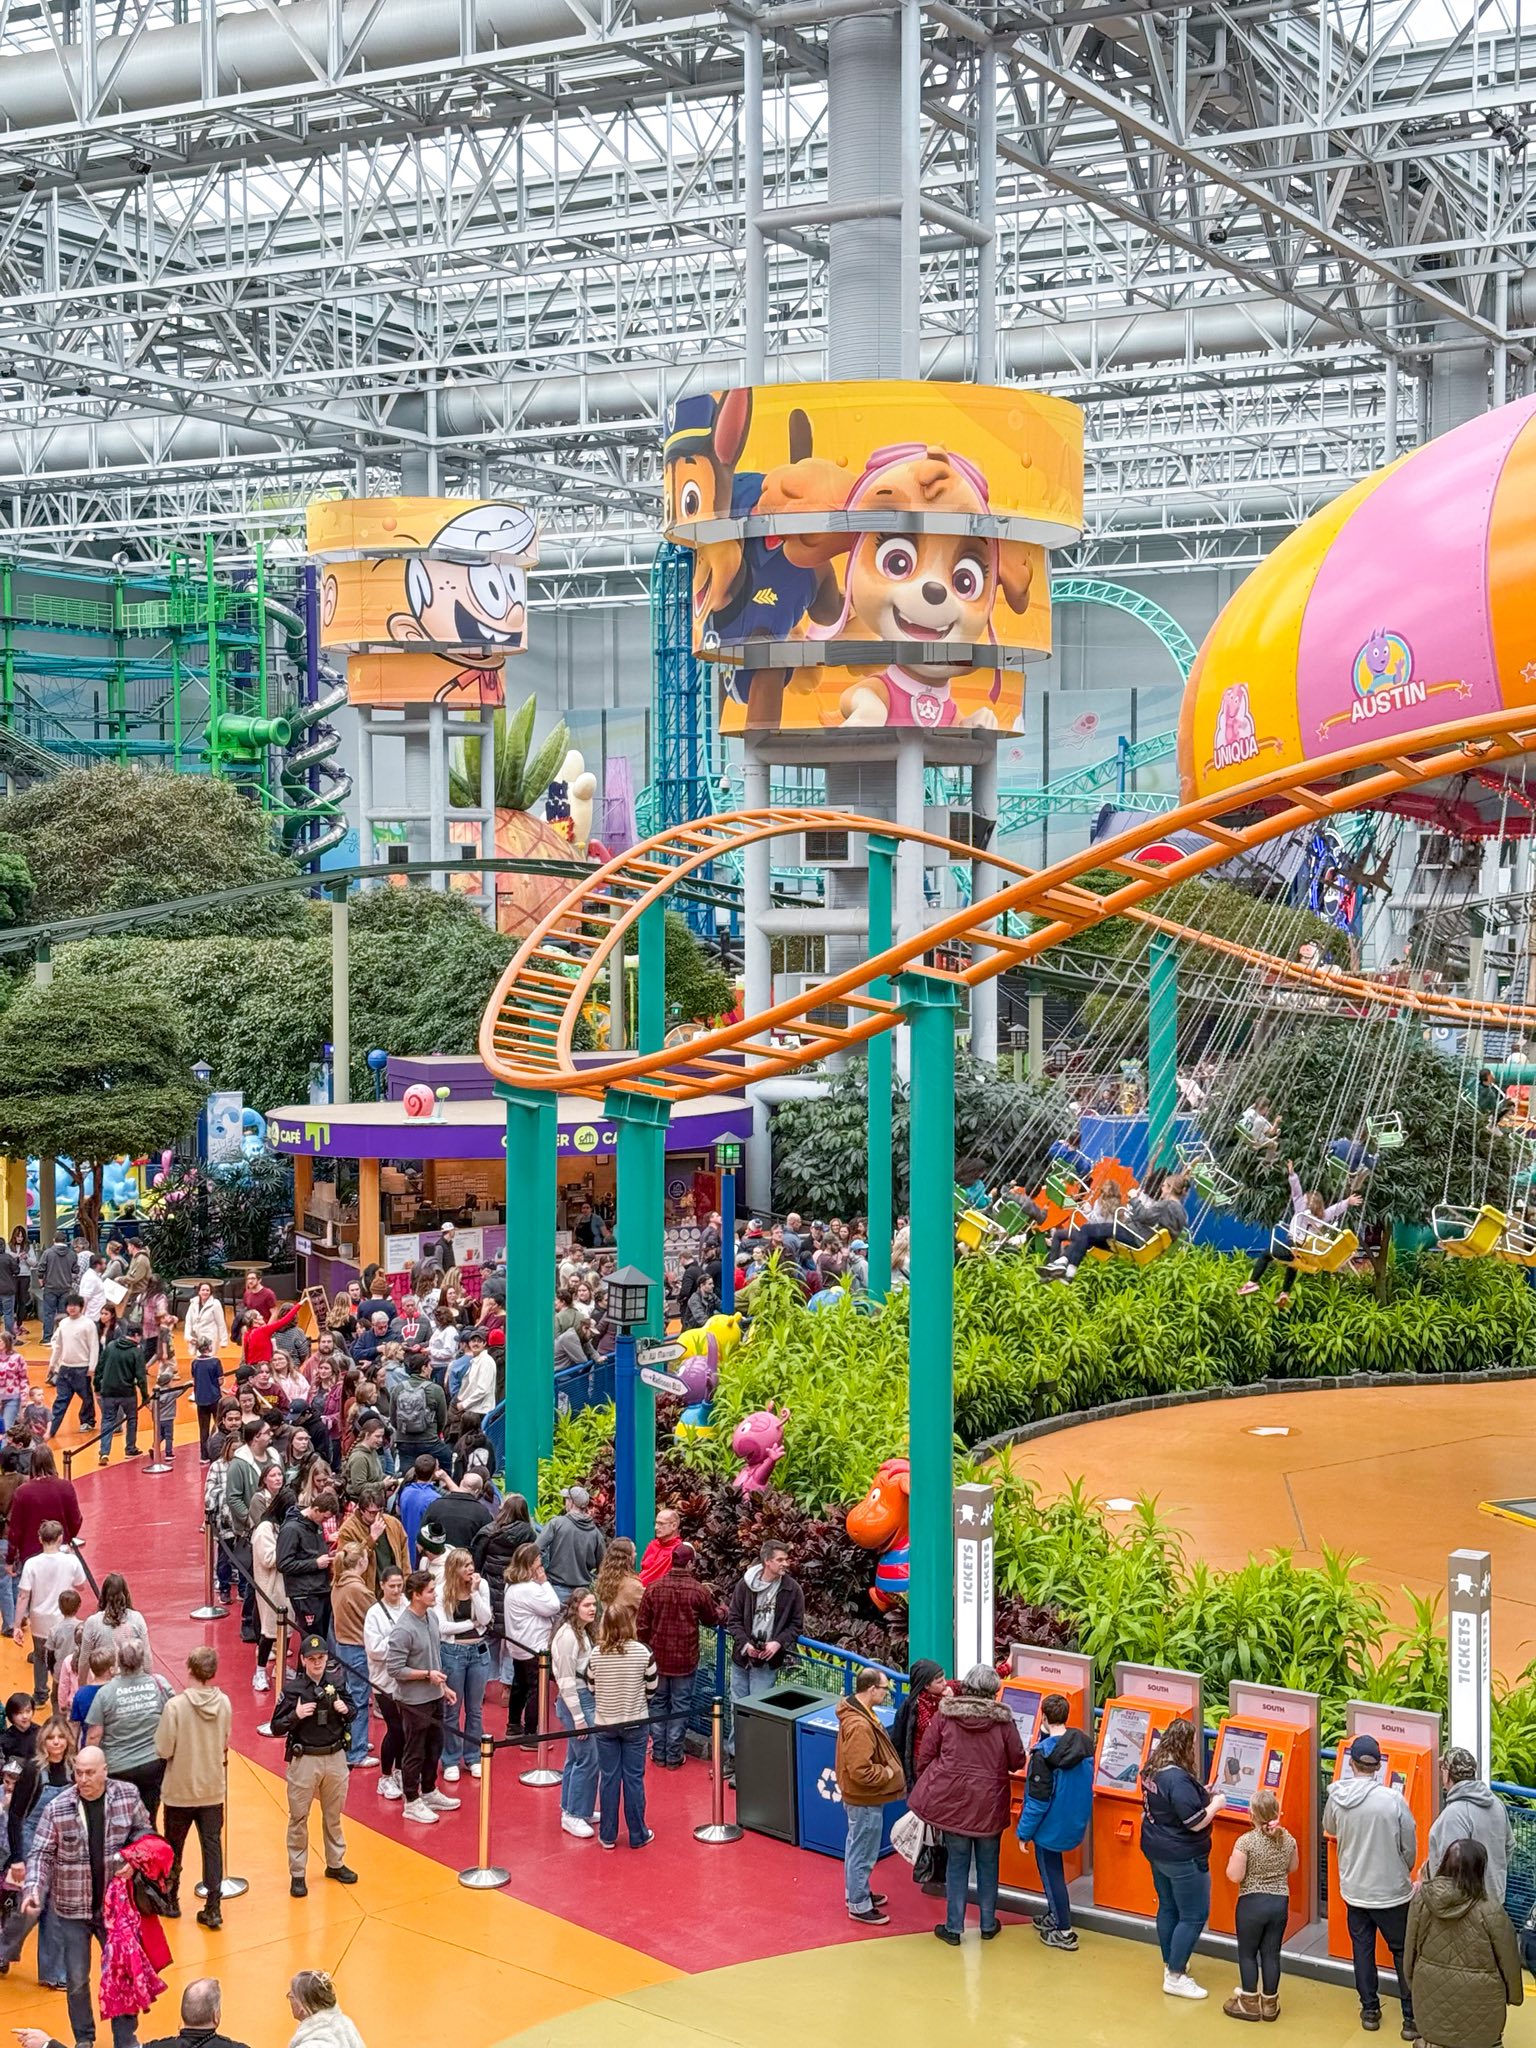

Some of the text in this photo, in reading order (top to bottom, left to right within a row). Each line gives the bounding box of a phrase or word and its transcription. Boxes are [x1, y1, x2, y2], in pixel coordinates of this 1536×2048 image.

[1351, 680, 1427, 724] AUSTIN
[1213, 734, 1259, 770] UNIQUA
[280, 1128, 301, 1145] CAFÉ
[963, 1544, 974, 1604] TICKETS
[1457, 1617, 1471, 1685] TICKETS
[1040, 1665, 1062, 1675] SOUTH
[1147, 1683, 1169, 1694] SOUTH
[1262, 1703, 1285, 1713] SOUTH
[1381, 1723, 1406, 1734] SOUTH
